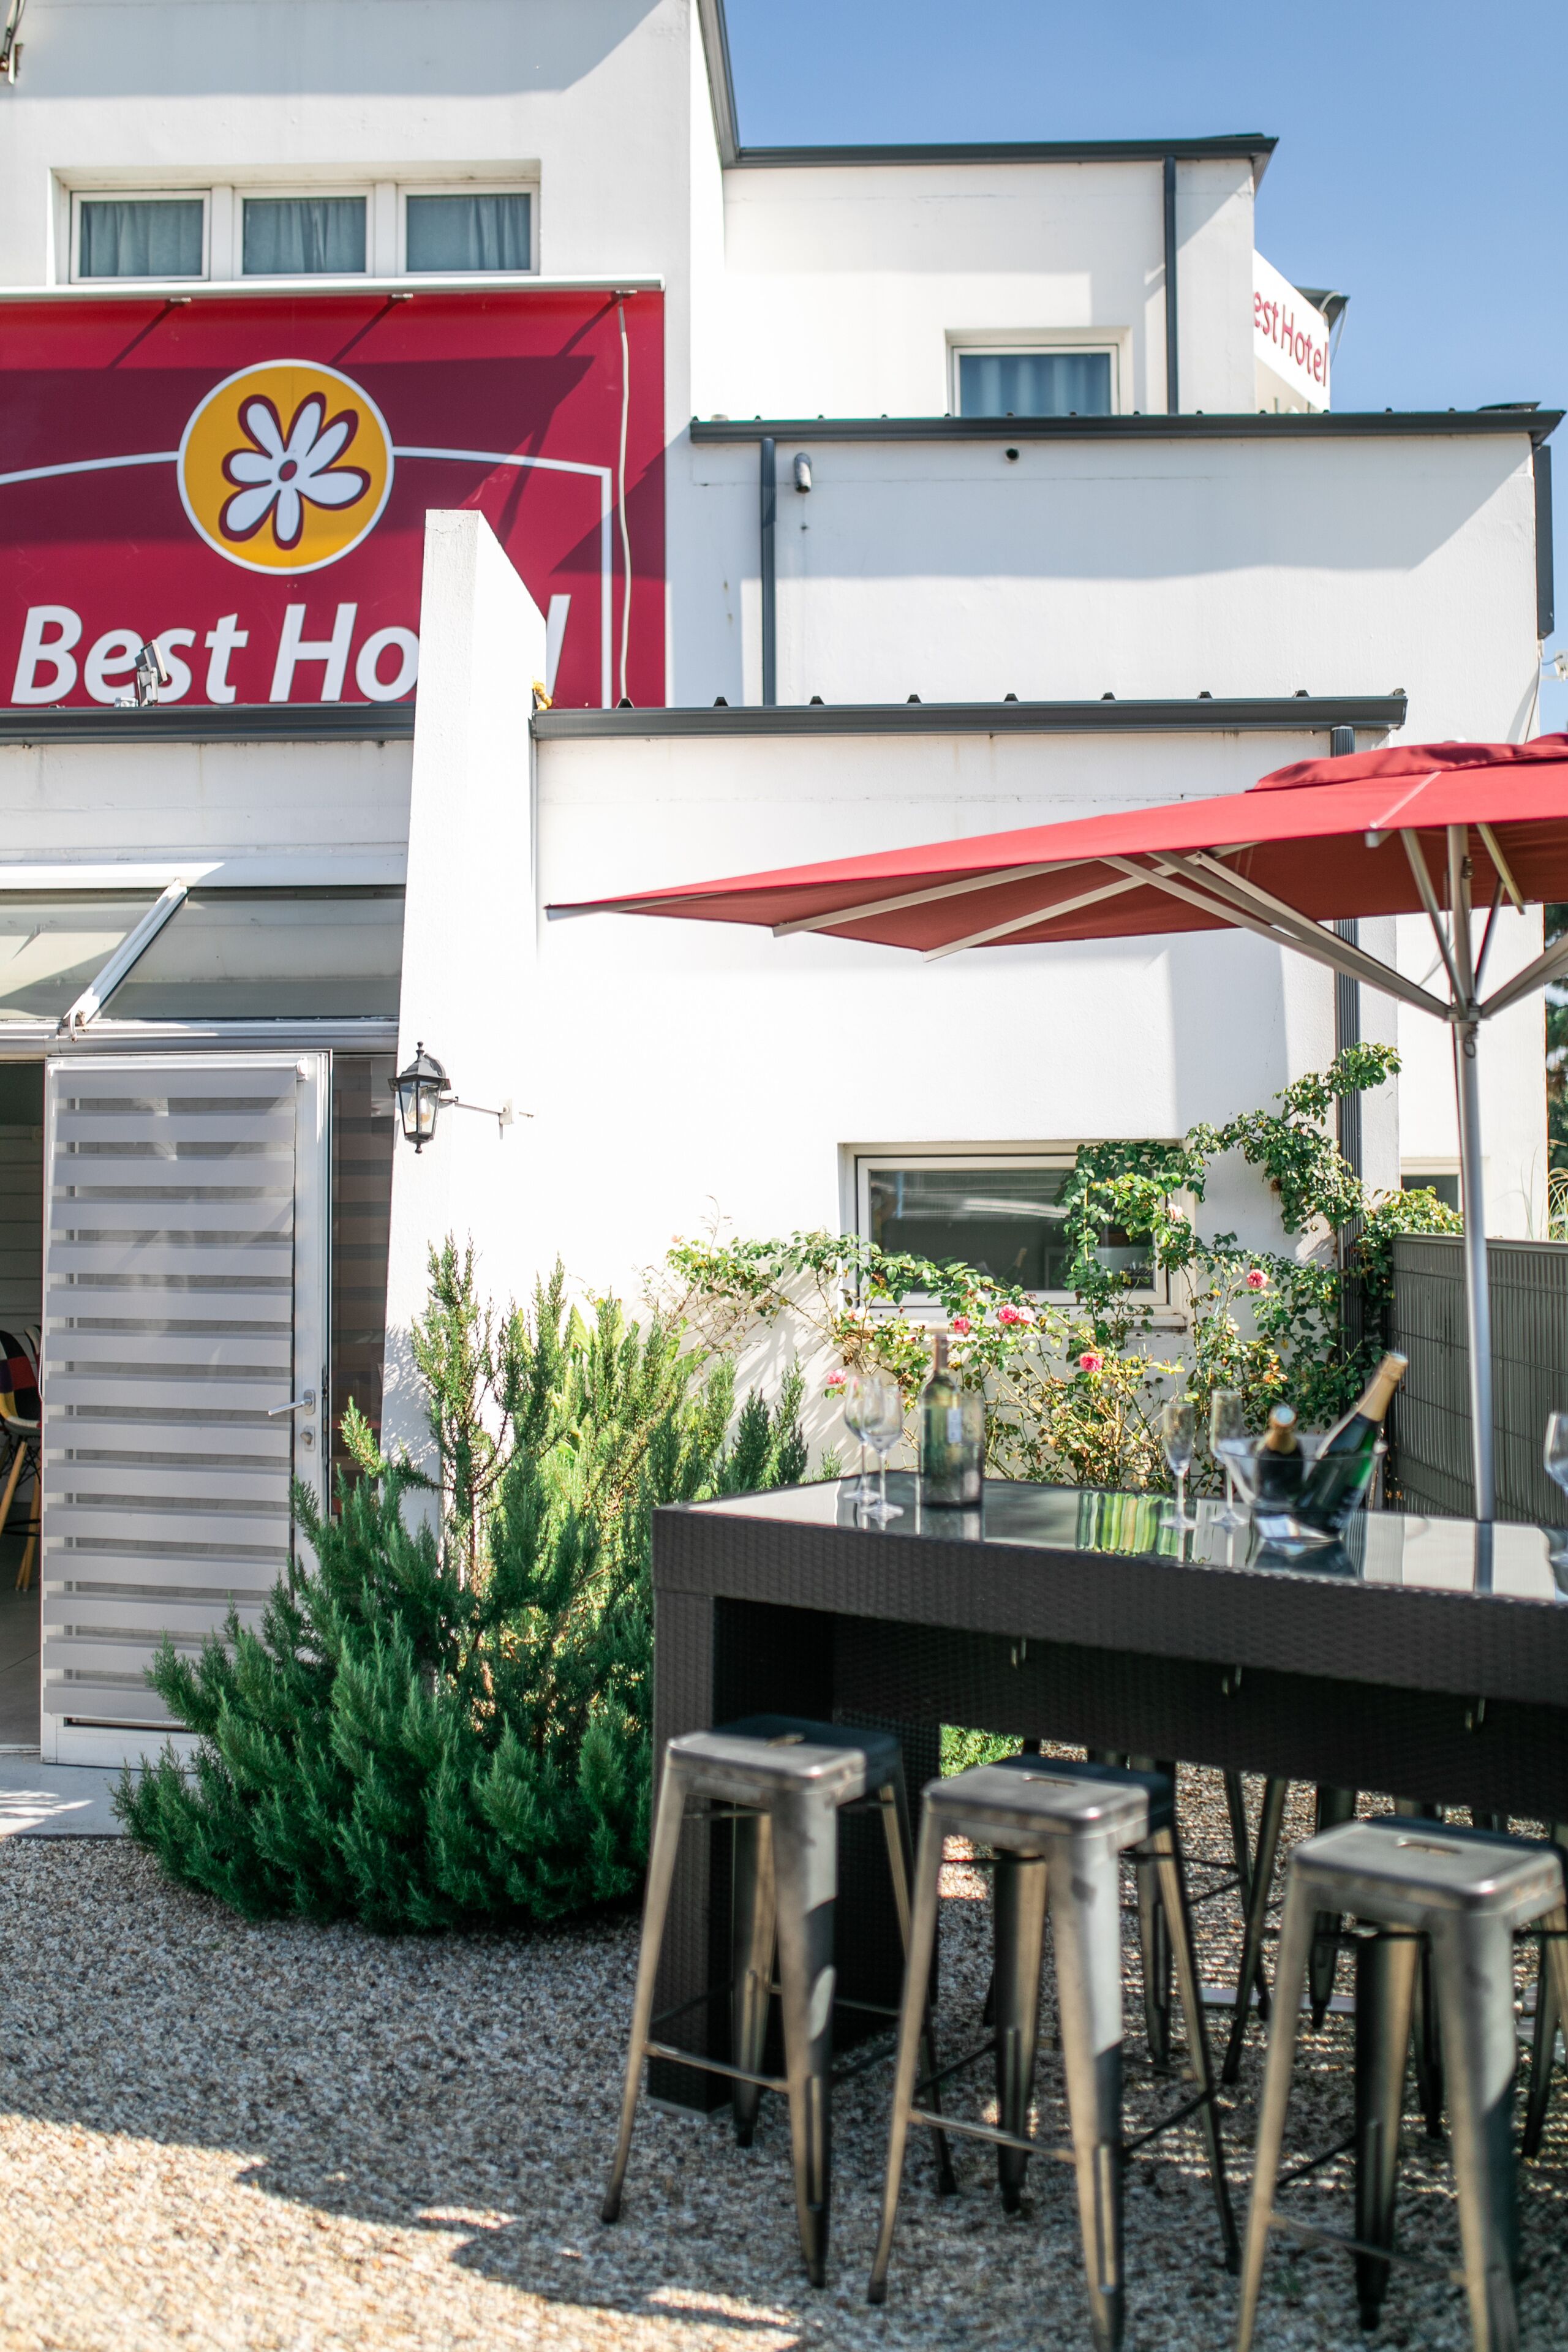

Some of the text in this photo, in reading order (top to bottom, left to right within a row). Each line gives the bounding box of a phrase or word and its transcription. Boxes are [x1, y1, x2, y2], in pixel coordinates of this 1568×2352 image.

[1254, 291, 1328, 386] est Hotel
[11, 594, 571, 704] Best Hol
